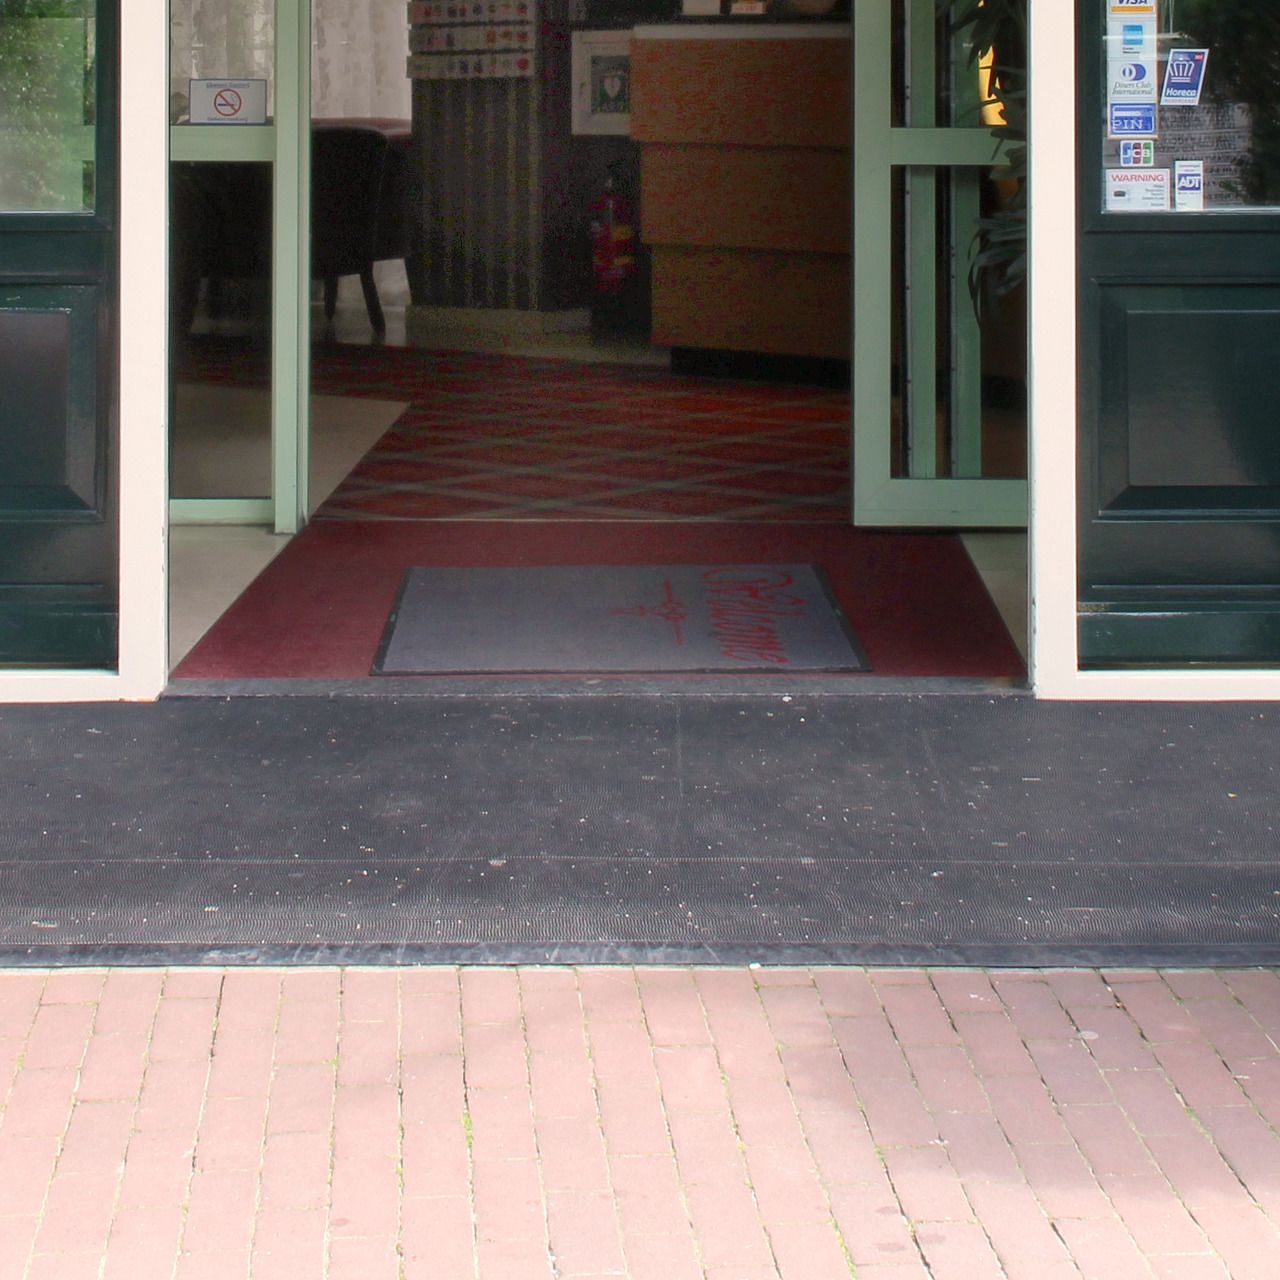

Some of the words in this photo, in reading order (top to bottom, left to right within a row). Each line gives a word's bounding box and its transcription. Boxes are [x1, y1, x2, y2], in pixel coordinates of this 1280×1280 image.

[1166, 87, 1197, 96] Horeca
[1112, 119, 1144, 129] PIN
[1122, 149, 1152, 158] JCB
[1111, 174, 1165, 182] WARNING
[1178, 175, 1201, 188] ADT
